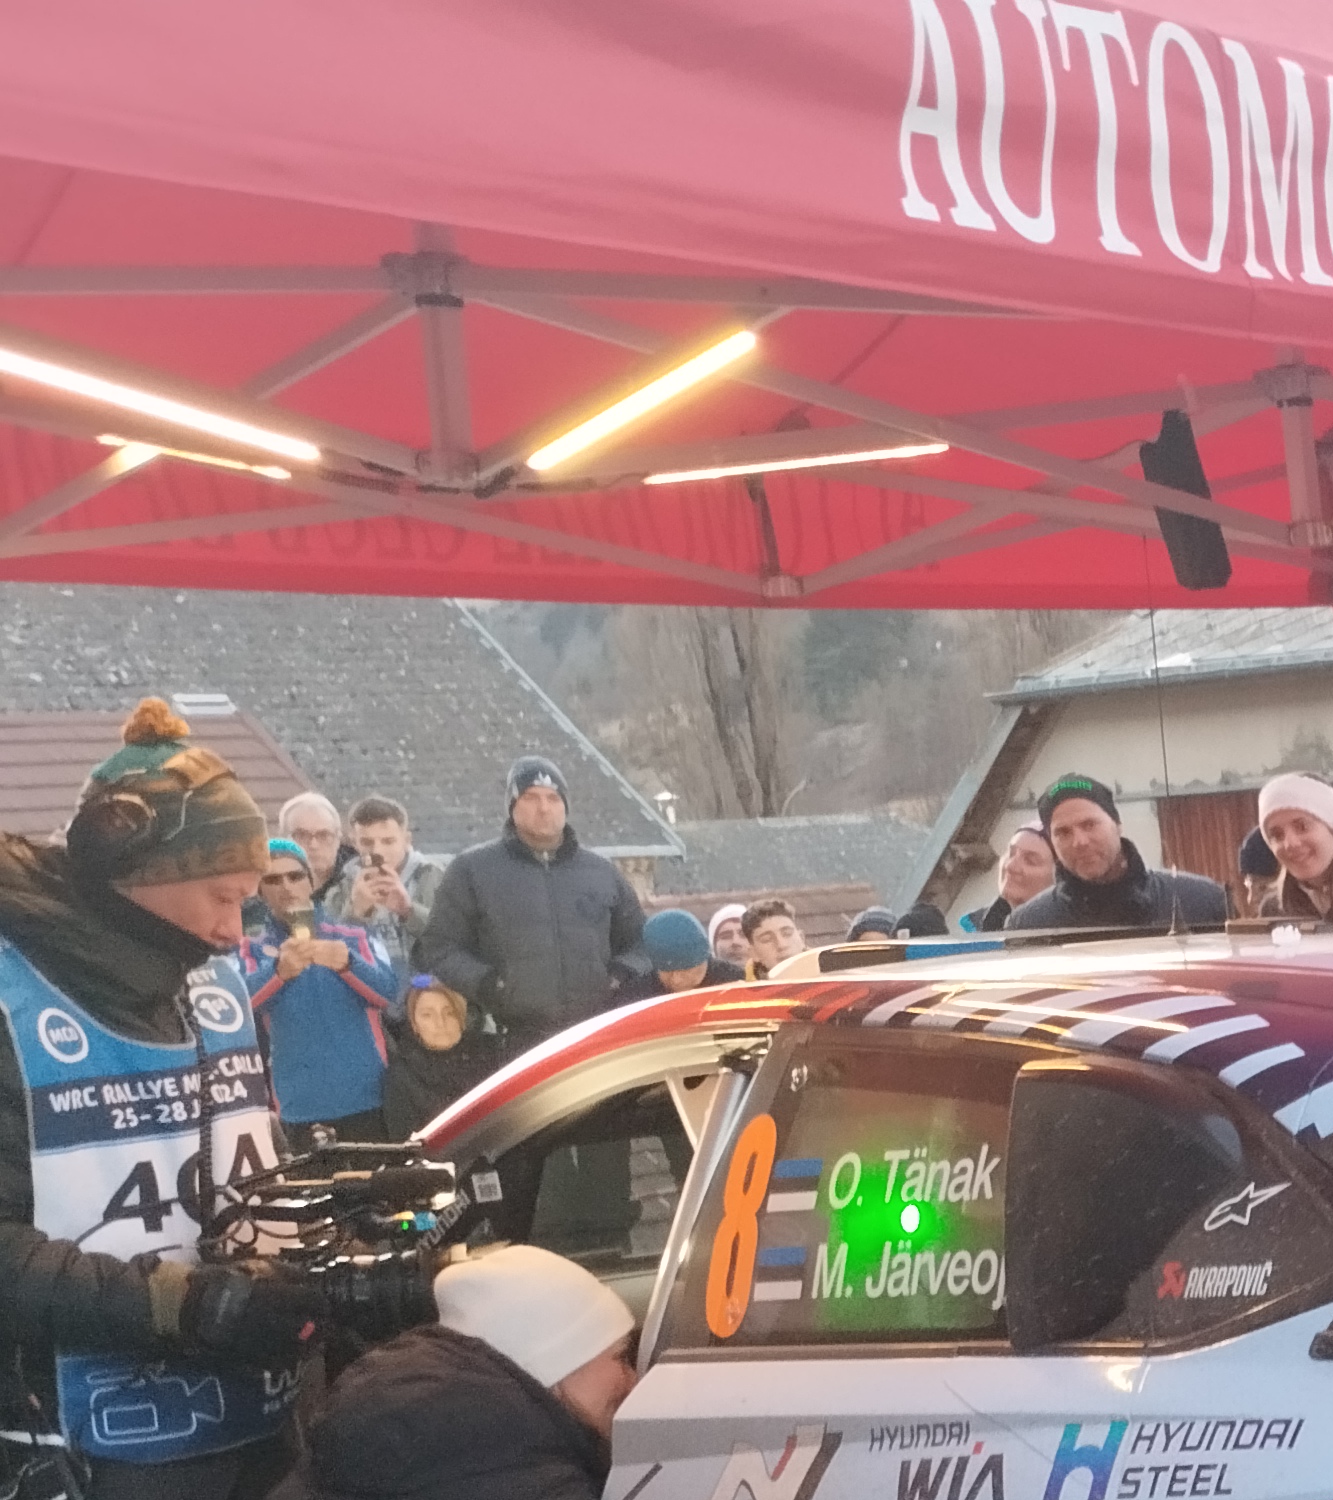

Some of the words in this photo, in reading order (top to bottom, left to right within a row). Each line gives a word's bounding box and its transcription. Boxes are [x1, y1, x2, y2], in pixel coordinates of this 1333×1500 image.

[49, 1086, 99, 1114] WRC
[101, 1074, 179, 1105] RALLYE
[828, 1152, 864, 1210] O.
[883, 1142, 1002, 1205] Tänak
[706, 1113, 778, 1338] 8
[811, 1242, 854, 1300] M.
[868, 1421, 972, 1453] HYUNDAI
[1130, 1417, 1306, 1455] HYUNDAI
[1115, 1461, 1235, 1500] STEEL
